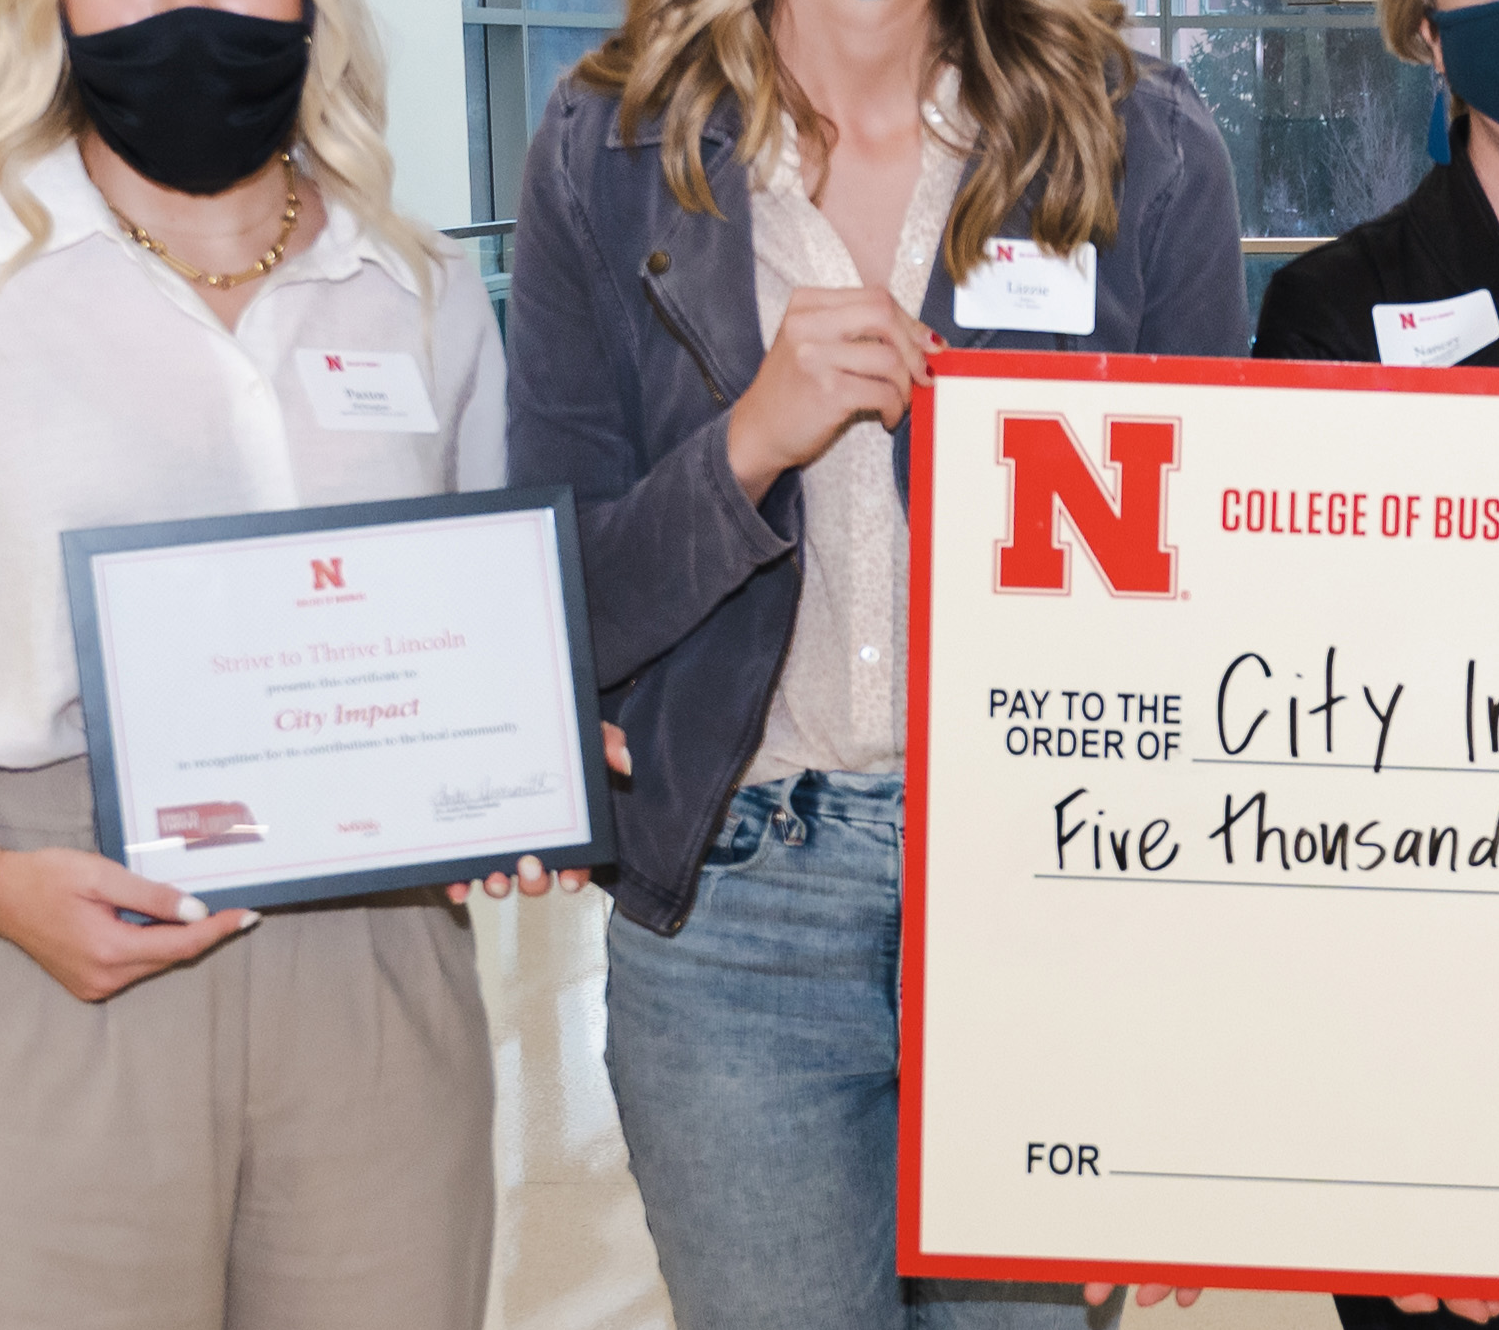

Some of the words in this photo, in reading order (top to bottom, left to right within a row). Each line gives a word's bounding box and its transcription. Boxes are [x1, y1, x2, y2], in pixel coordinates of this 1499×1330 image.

[996, 245, 1014, 262] N
[1399, 313, 1417, 330] N
[324, 355, 344, 372] N
[992, 410, 1182, 600] N
[1221, 488, 1367, 536] COLLEGE
[1380, 494, 1421, 538] OF
[310, 557, 346, 590] N
[212, 653, 274, 674] Strive
[280, 650, 302, 667] to
[308, 641, 379, 664] Thrive
[384, 629, 466, 657] Lincoln
[404, 669, 418, 680] to
[275, 708, 327, 735] City
[335, 698, 419, 729] Impact
[989, 687, 1051, 720] PAY
[1061, 690, 1106, 723] TO
[1116, 692, 1182, 725] THE
[1216, 645, 1405, 772] City
[1005, 725, 1125, 760] ORDER
[1136, 729, 1182, 762] OF
[1053, 787, 1181, 872] Five
[1027, 1141, 1101, 1177] FOR
